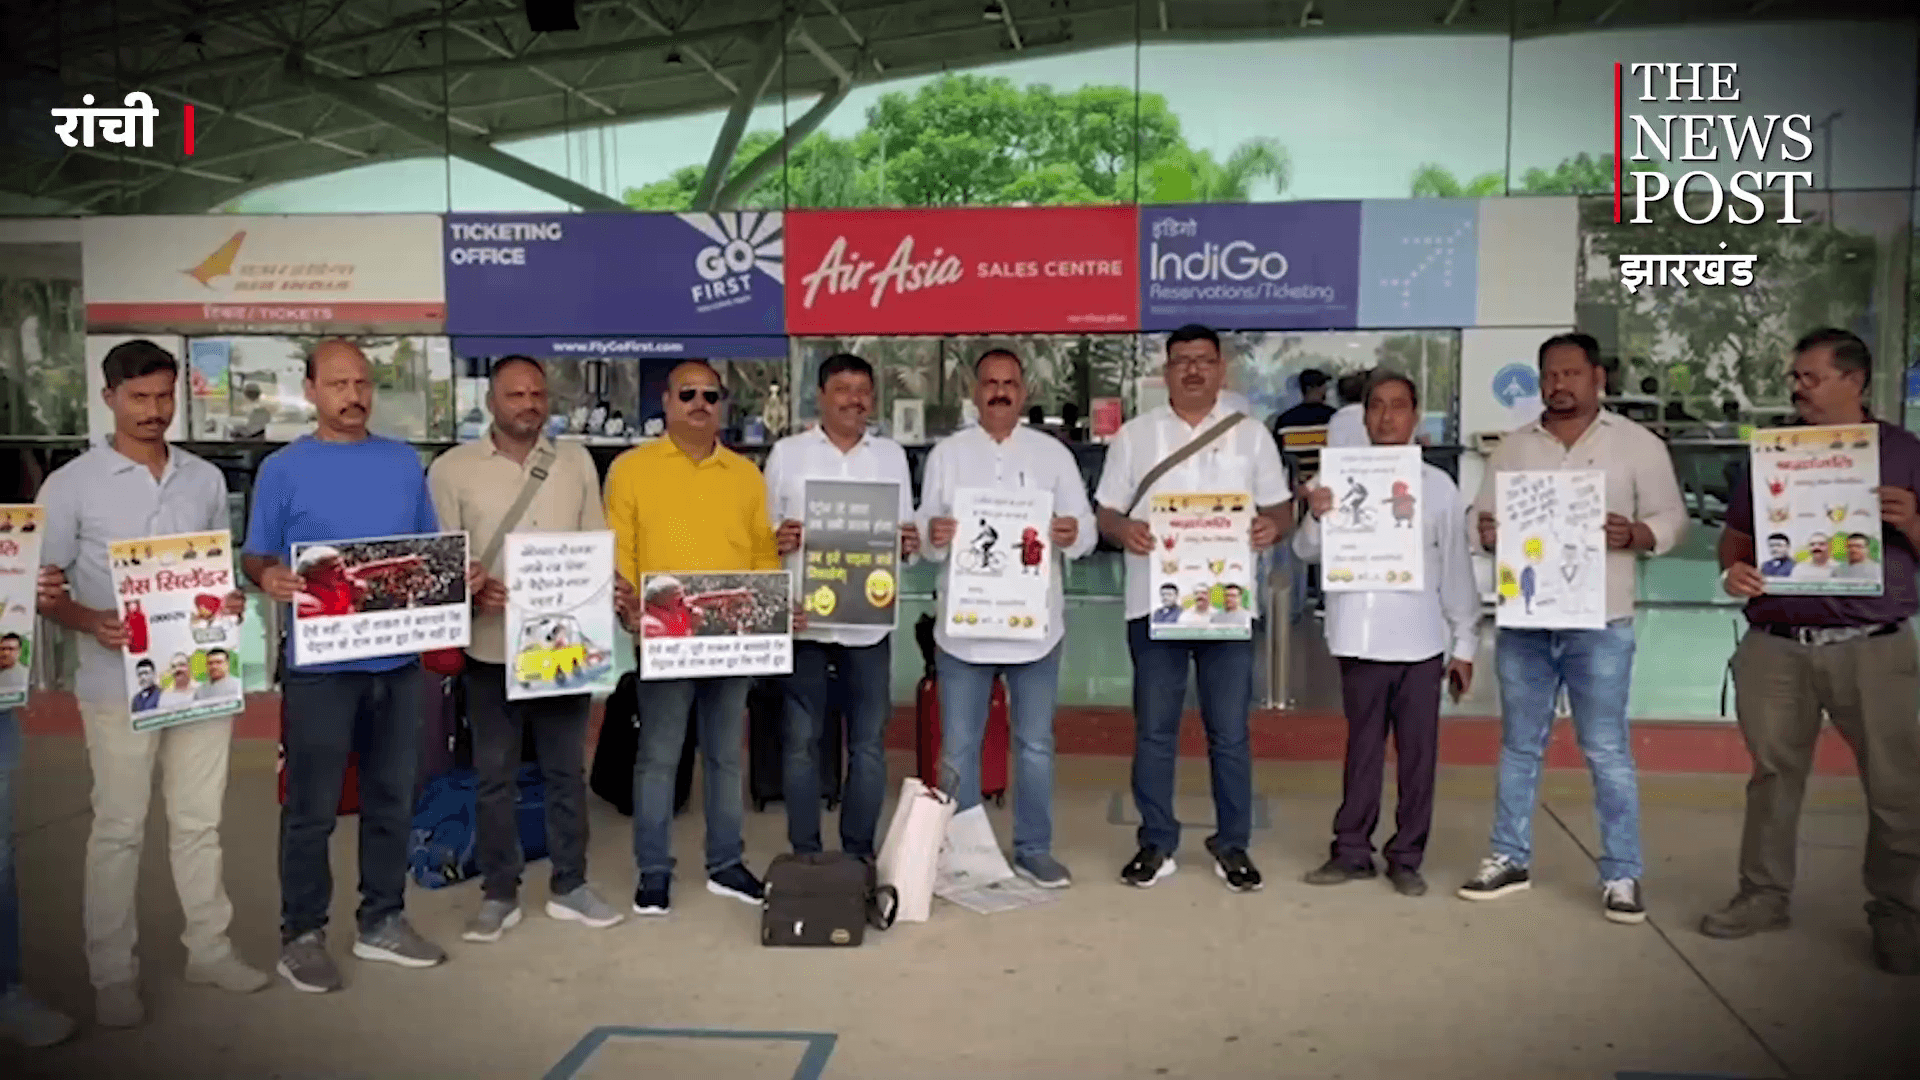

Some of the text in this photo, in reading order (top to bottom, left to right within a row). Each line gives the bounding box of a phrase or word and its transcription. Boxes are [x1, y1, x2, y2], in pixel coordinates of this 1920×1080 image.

[450, 223, 562, 241] TICKETING
[450, 247, 525, 265] OFFICE
[695, 239, 755, 281] GO
[1150, 240, 1289, 281] IndiGo
[976, 260, 1123, 278] SALES CENTRE
[691, 273, 751, 303] FIRST
[552, 340, 684, 354] www.FlyGoFirst.com
[119, 575, 151, 595] गैस
